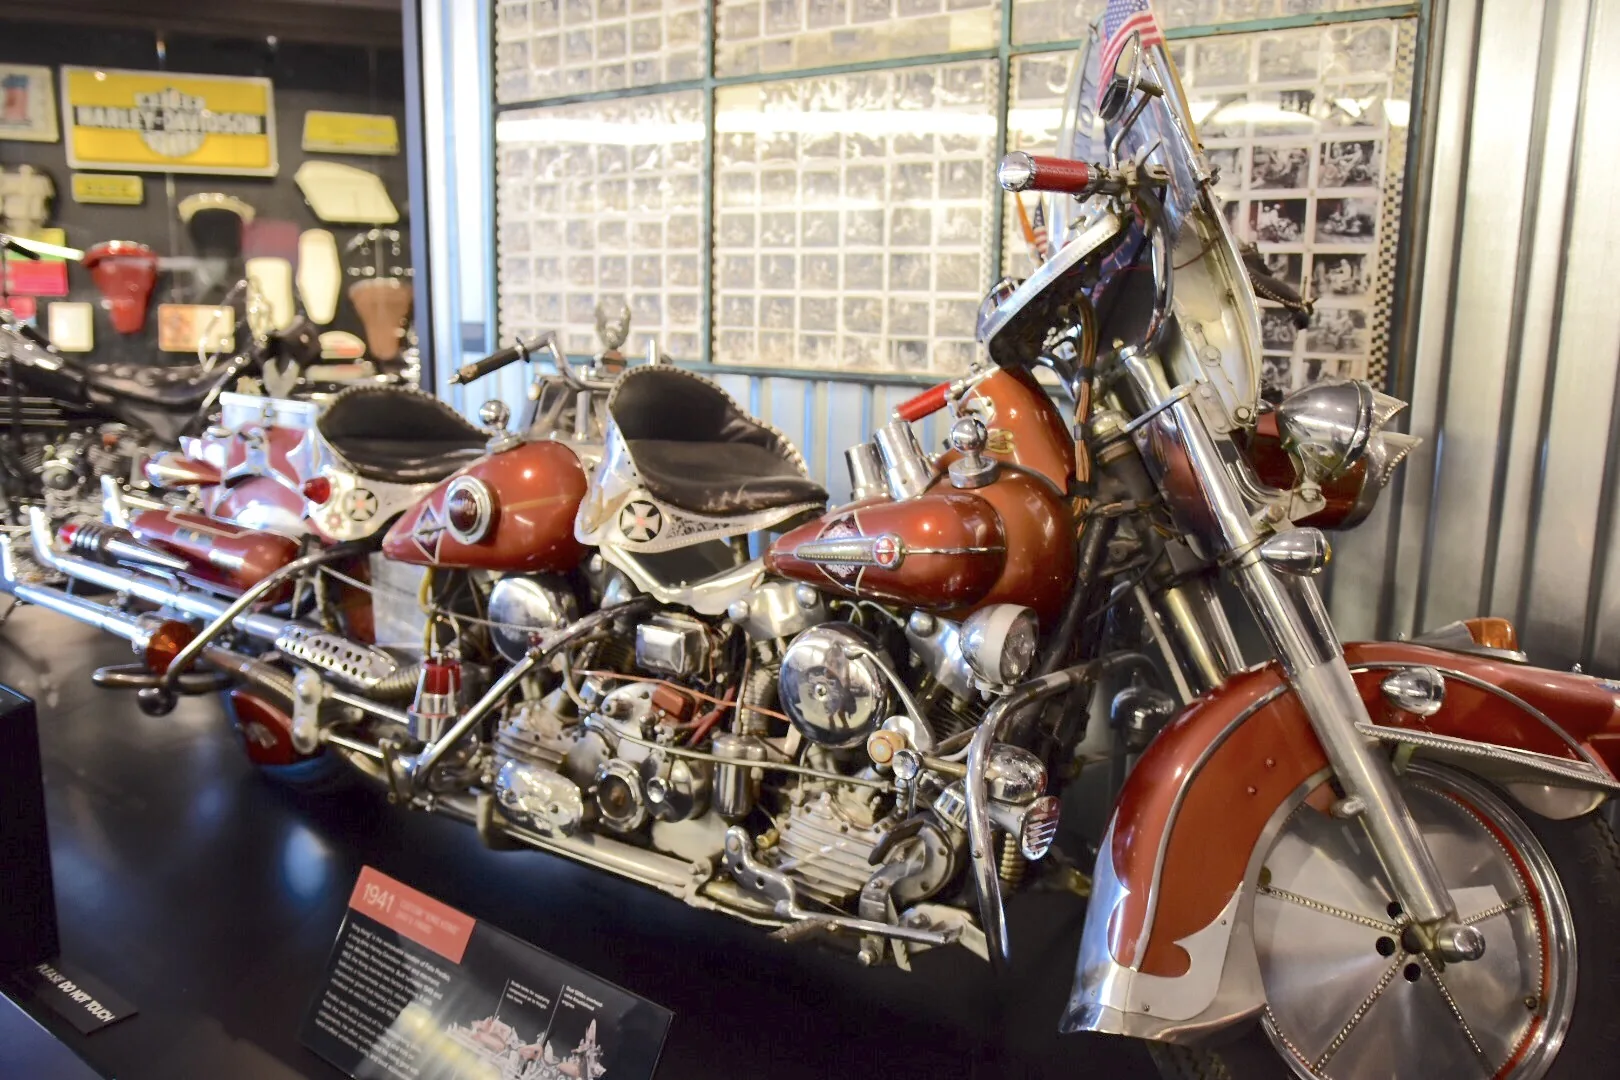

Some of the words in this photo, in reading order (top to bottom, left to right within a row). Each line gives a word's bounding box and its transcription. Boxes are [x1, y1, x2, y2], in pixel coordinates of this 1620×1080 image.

[77, 106, 261, 135] HARLEY-DAVIDSON
[362, 883, 395, 913] 1941
[36, 964, 65, 983] PLEASE
[57, 981, 75, 992] DO
[69, 989, 92, 1003] NOT
[84, 1000, 116, 1022] TOUCH
